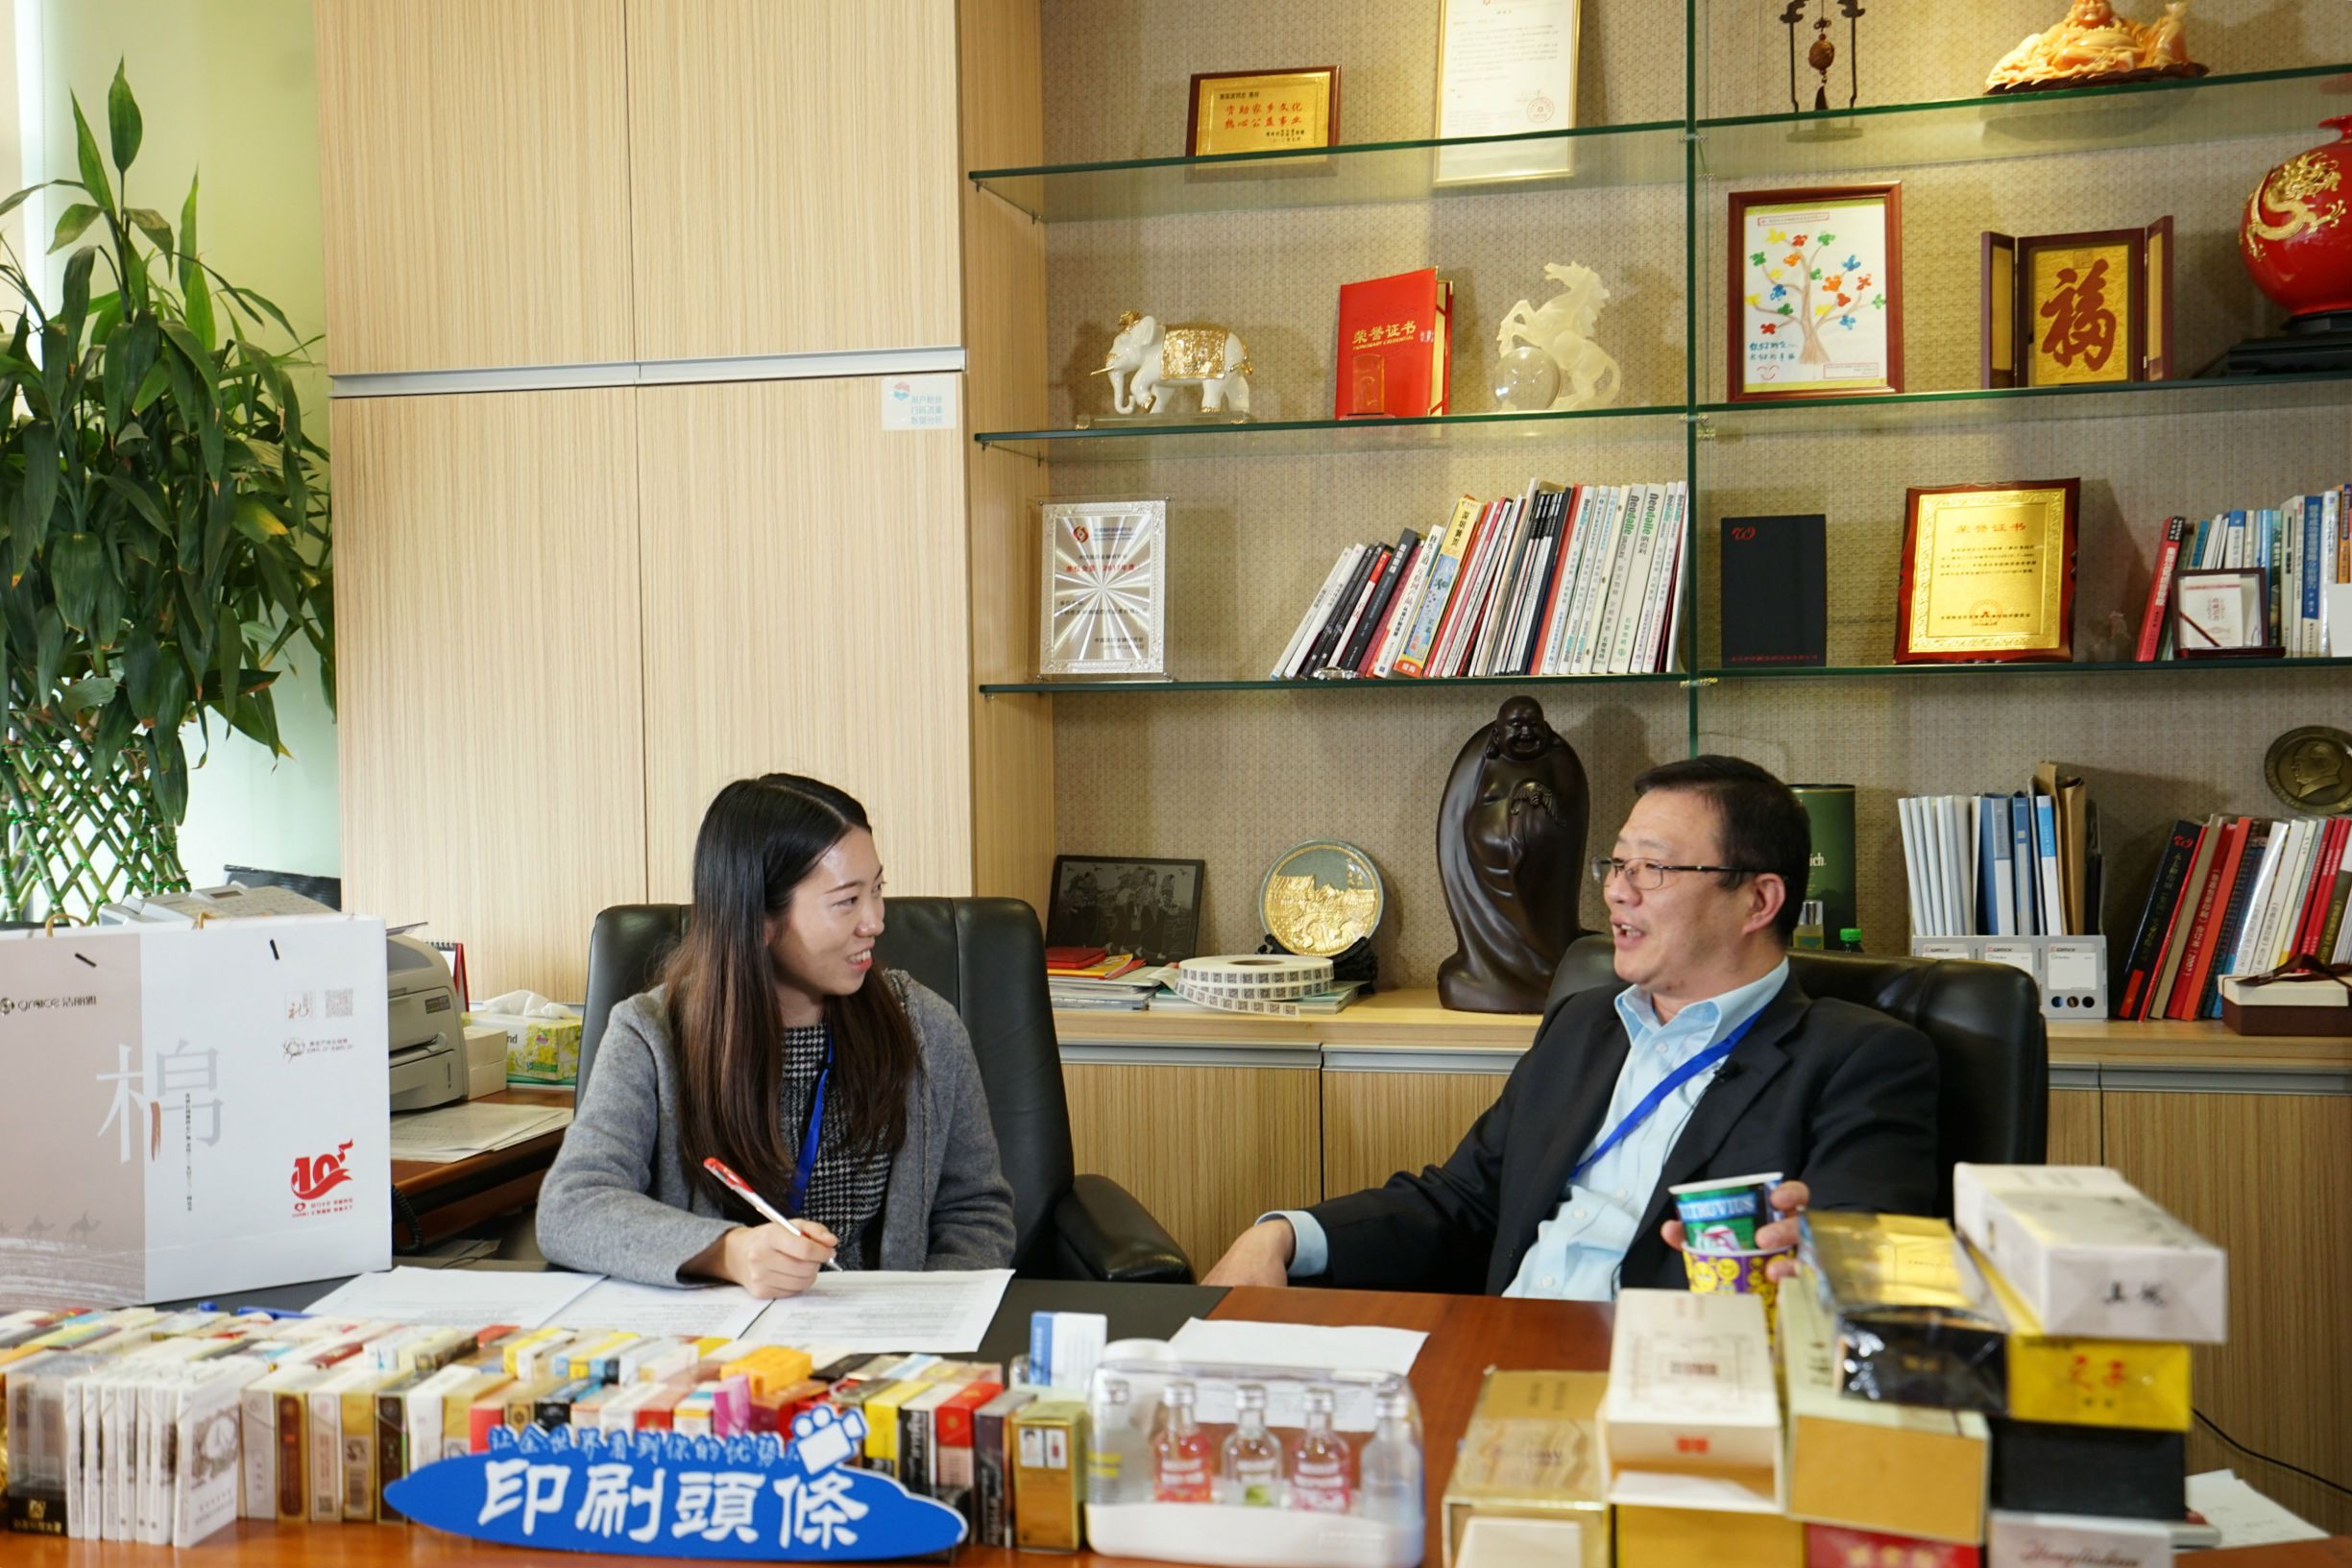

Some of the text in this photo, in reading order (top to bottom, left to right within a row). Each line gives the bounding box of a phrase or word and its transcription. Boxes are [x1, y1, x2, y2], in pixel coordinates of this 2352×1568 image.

[1352, 320, 1417, 344] 荣誉证书
[2040, 258, 2116, 373] 福
[1809, 853, 1827, 867] ich.
[507, 1034, 518, 1044] nd
[96, 1038, 223, 1165] 棉
[477, 1458, 869, 1550] 印刷頭條
